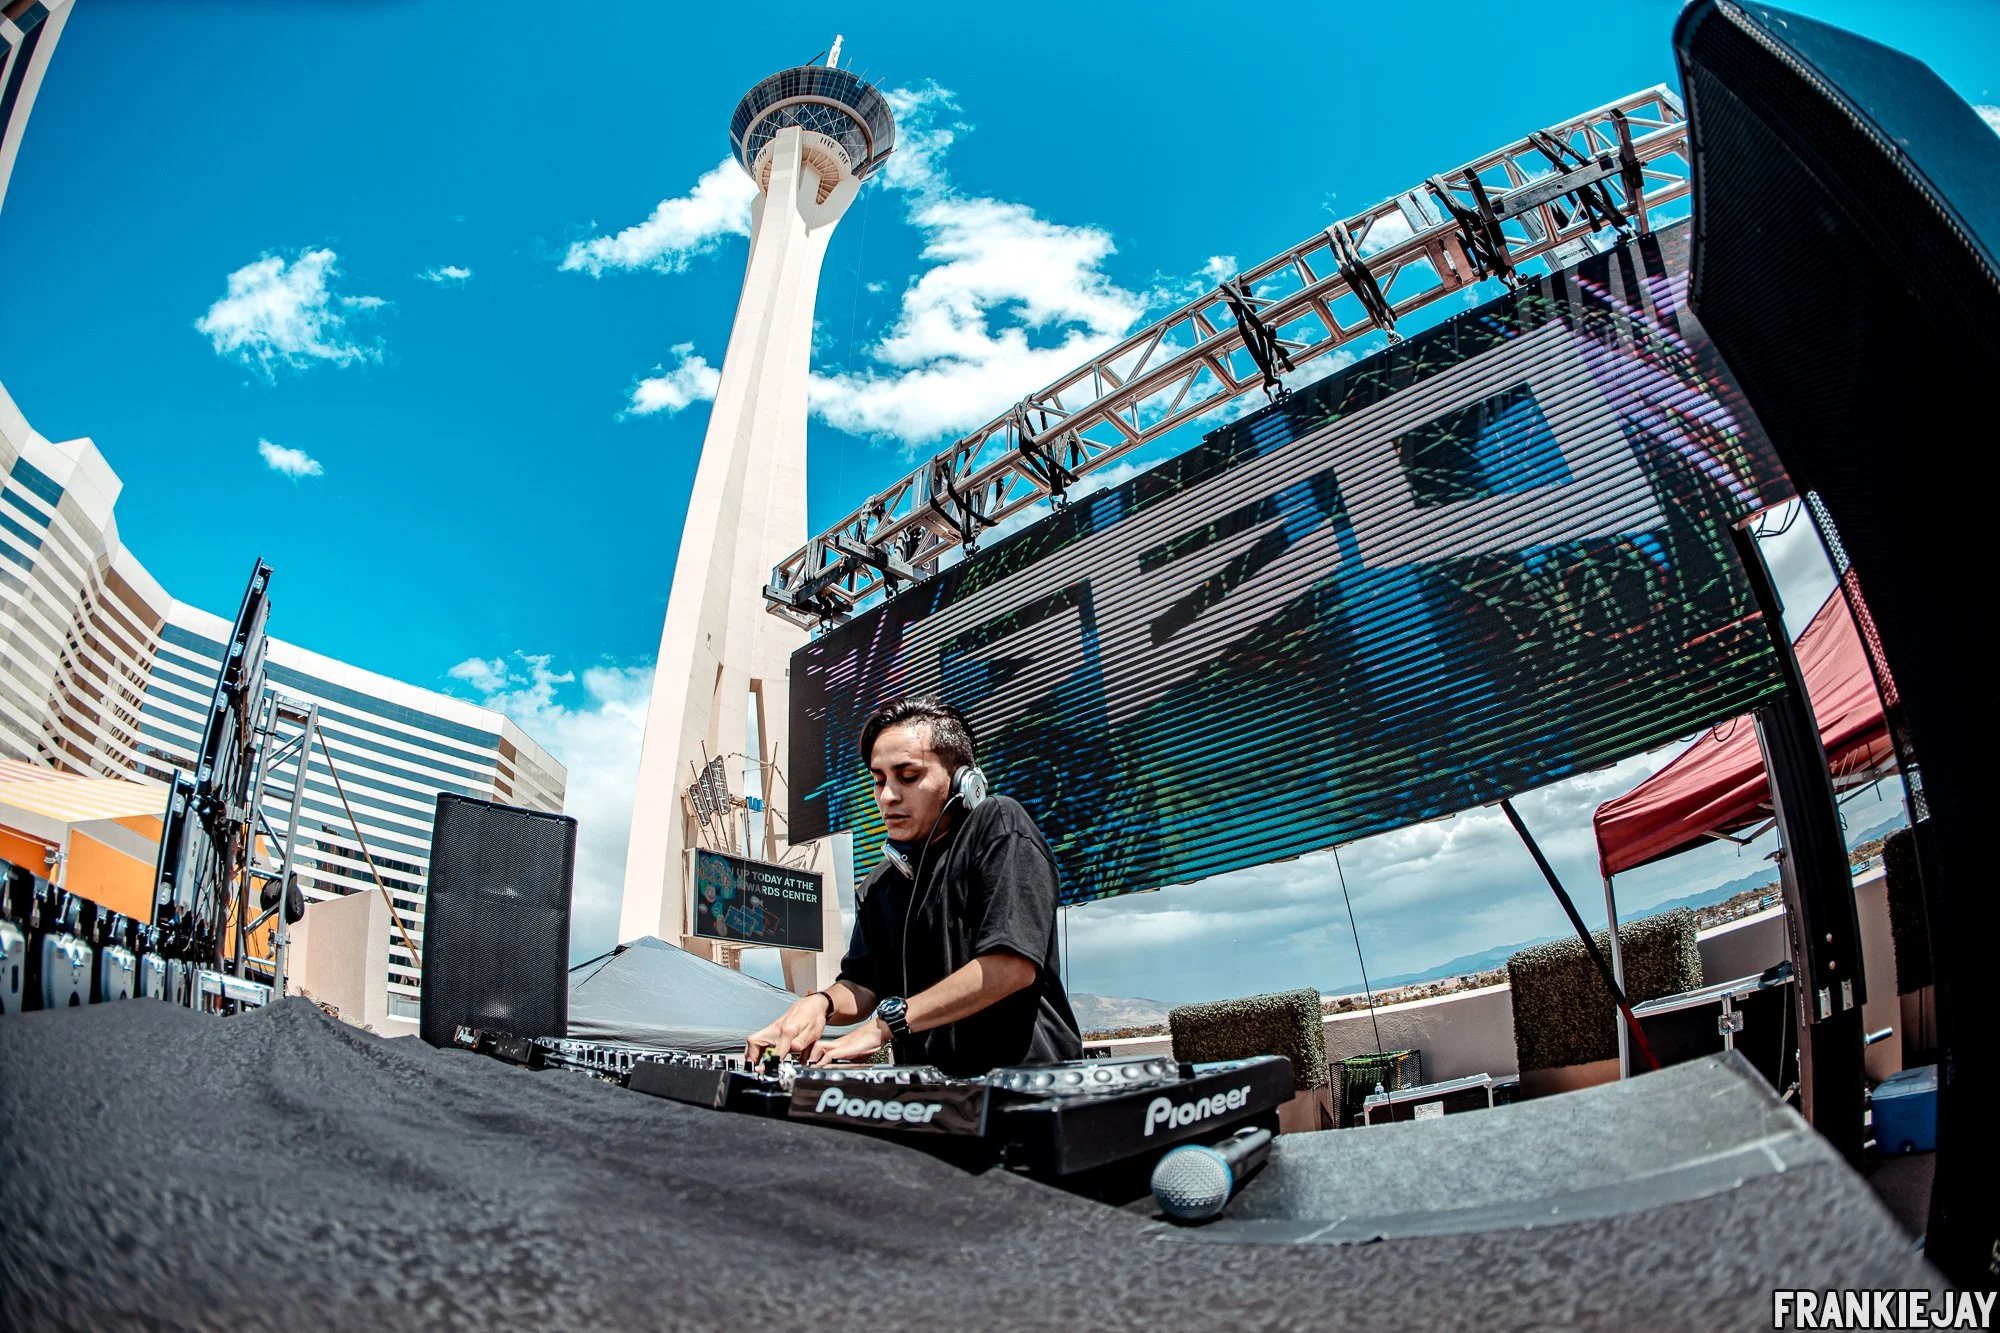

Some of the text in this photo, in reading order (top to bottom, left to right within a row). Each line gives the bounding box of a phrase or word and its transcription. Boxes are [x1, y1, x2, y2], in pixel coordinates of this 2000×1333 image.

[736, 868, 750, 877] UP
[752, 871, 783, 885] TODAY
[783, 877, 795, 887] AT
[796, 879, 815, 891] THE
[782, 889, 818, 903] CENTER
[815, 1087, 942, 1122] Pioneer
[1144, 1085, 1251, 1136] Pioneer
